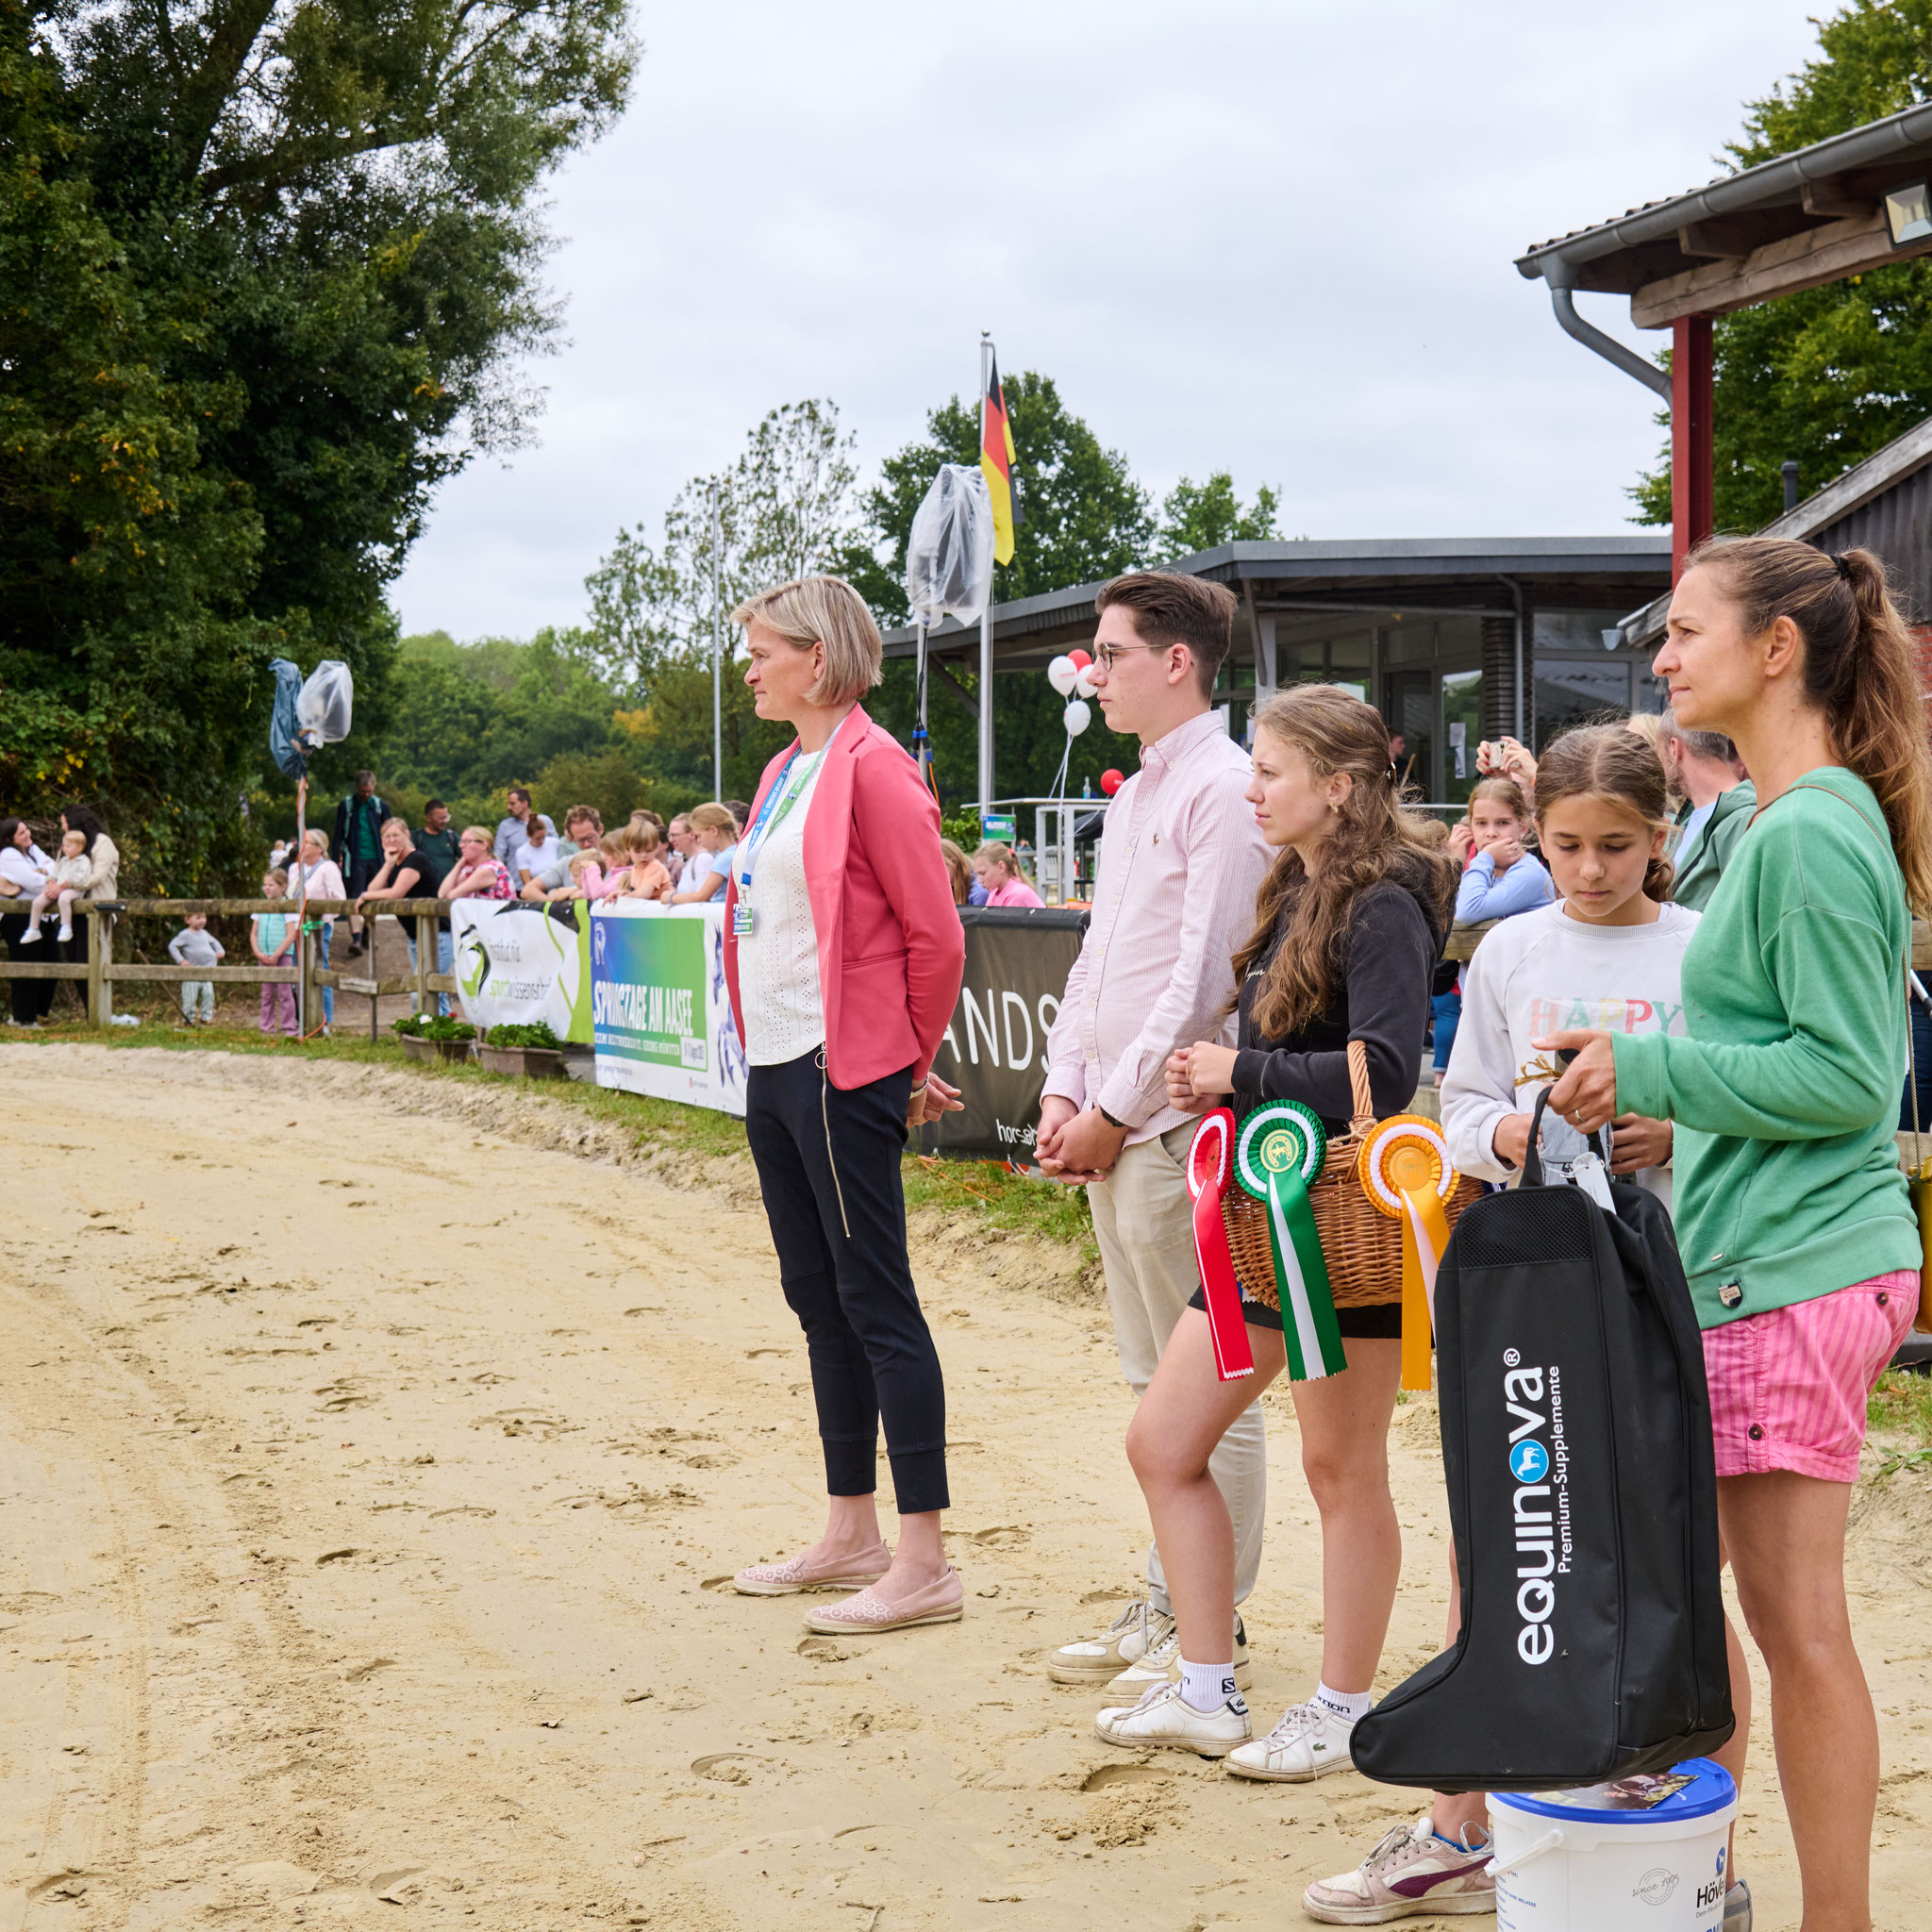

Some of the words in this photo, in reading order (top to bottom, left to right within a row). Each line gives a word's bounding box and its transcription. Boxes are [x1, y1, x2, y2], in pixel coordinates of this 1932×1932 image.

[648, 986, 663, 1033] AM
[664, 988, 693, 1037] AASEE
[1528, 998, 1683, 1037] HAPPY
[1549, 1365, 1573, 1574] Premium-Supplemente
